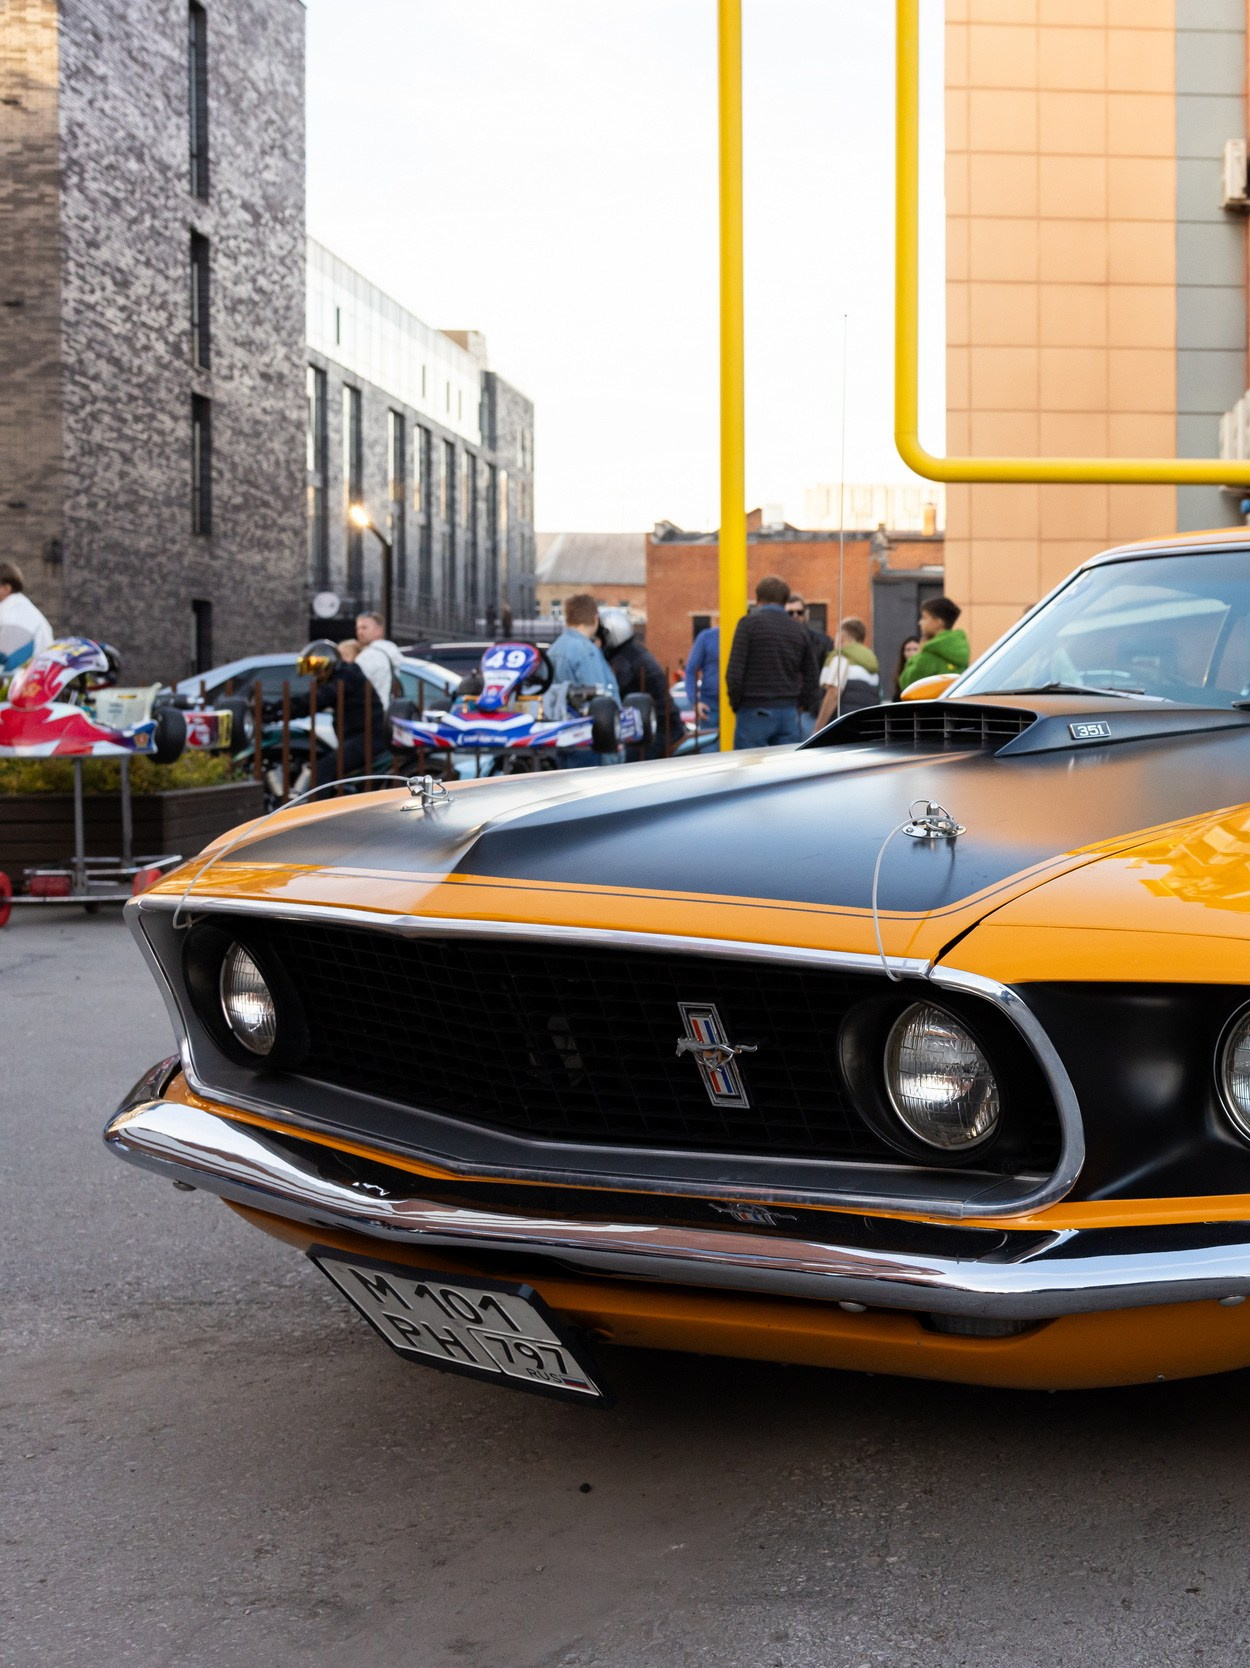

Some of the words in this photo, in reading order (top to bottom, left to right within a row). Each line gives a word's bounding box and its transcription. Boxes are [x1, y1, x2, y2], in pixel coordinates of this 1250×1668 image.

[486, 650, 526, 668] 49
[1078, 724, 1104, 736] 351
[484, 1334, 568, 1374] 797
[527, 1367, 563, 1385] RUS
